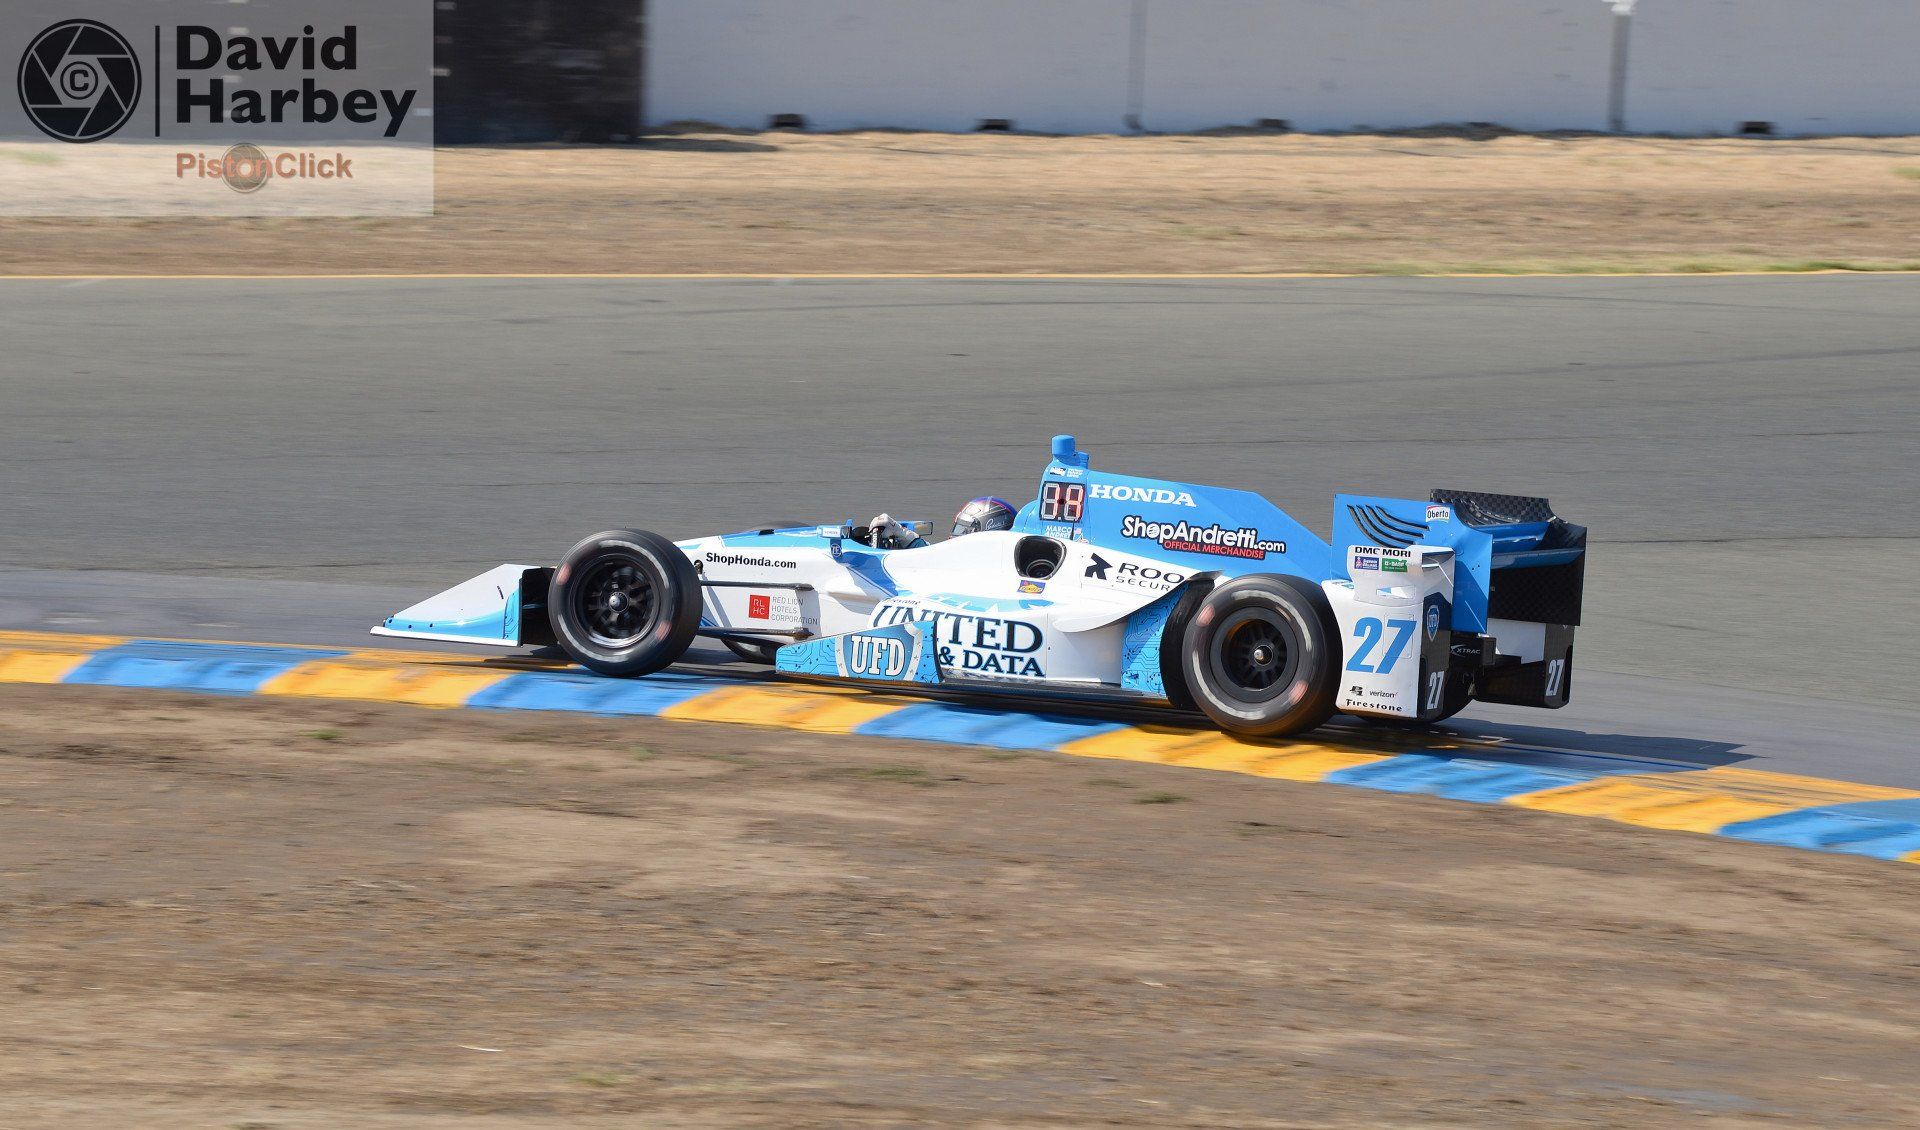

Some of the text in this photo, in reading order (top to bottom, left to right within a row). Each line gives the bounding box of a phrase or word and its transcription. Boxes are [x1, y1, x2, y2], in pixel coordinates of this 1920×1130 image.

[1089, 483, 1197, 508] HONDA
[1427, 510, 1449, 518] Oberto
[1122, 516, 1285, 552] ShopAndretti.com
[1164, 540, 1265, 559] OFFICIAL MERCHANDISE
[1382, 548, 1411, 557] MORI
[705, 552, 797, 569] ShopHonda.com
[753, 598, 765, 607] RL
[772, 596, 804, 606] RED LION
[753, 607, 765, 615] HC
[771, 606, 798, 614] HOTELS
[771, 614, 818, 625] CORPORATION
[1346, 617, 1417, 675] 27
[850, 635, 905, 677] UFD
[937, 646, 1046, 678] & DATA
[1545, 659, 1565, 696] 27
[1369, 690, 1397, 698] verizon
[1427, 670, 1445, 710] 27
[1345, 699, 1403, 712] Firestone
